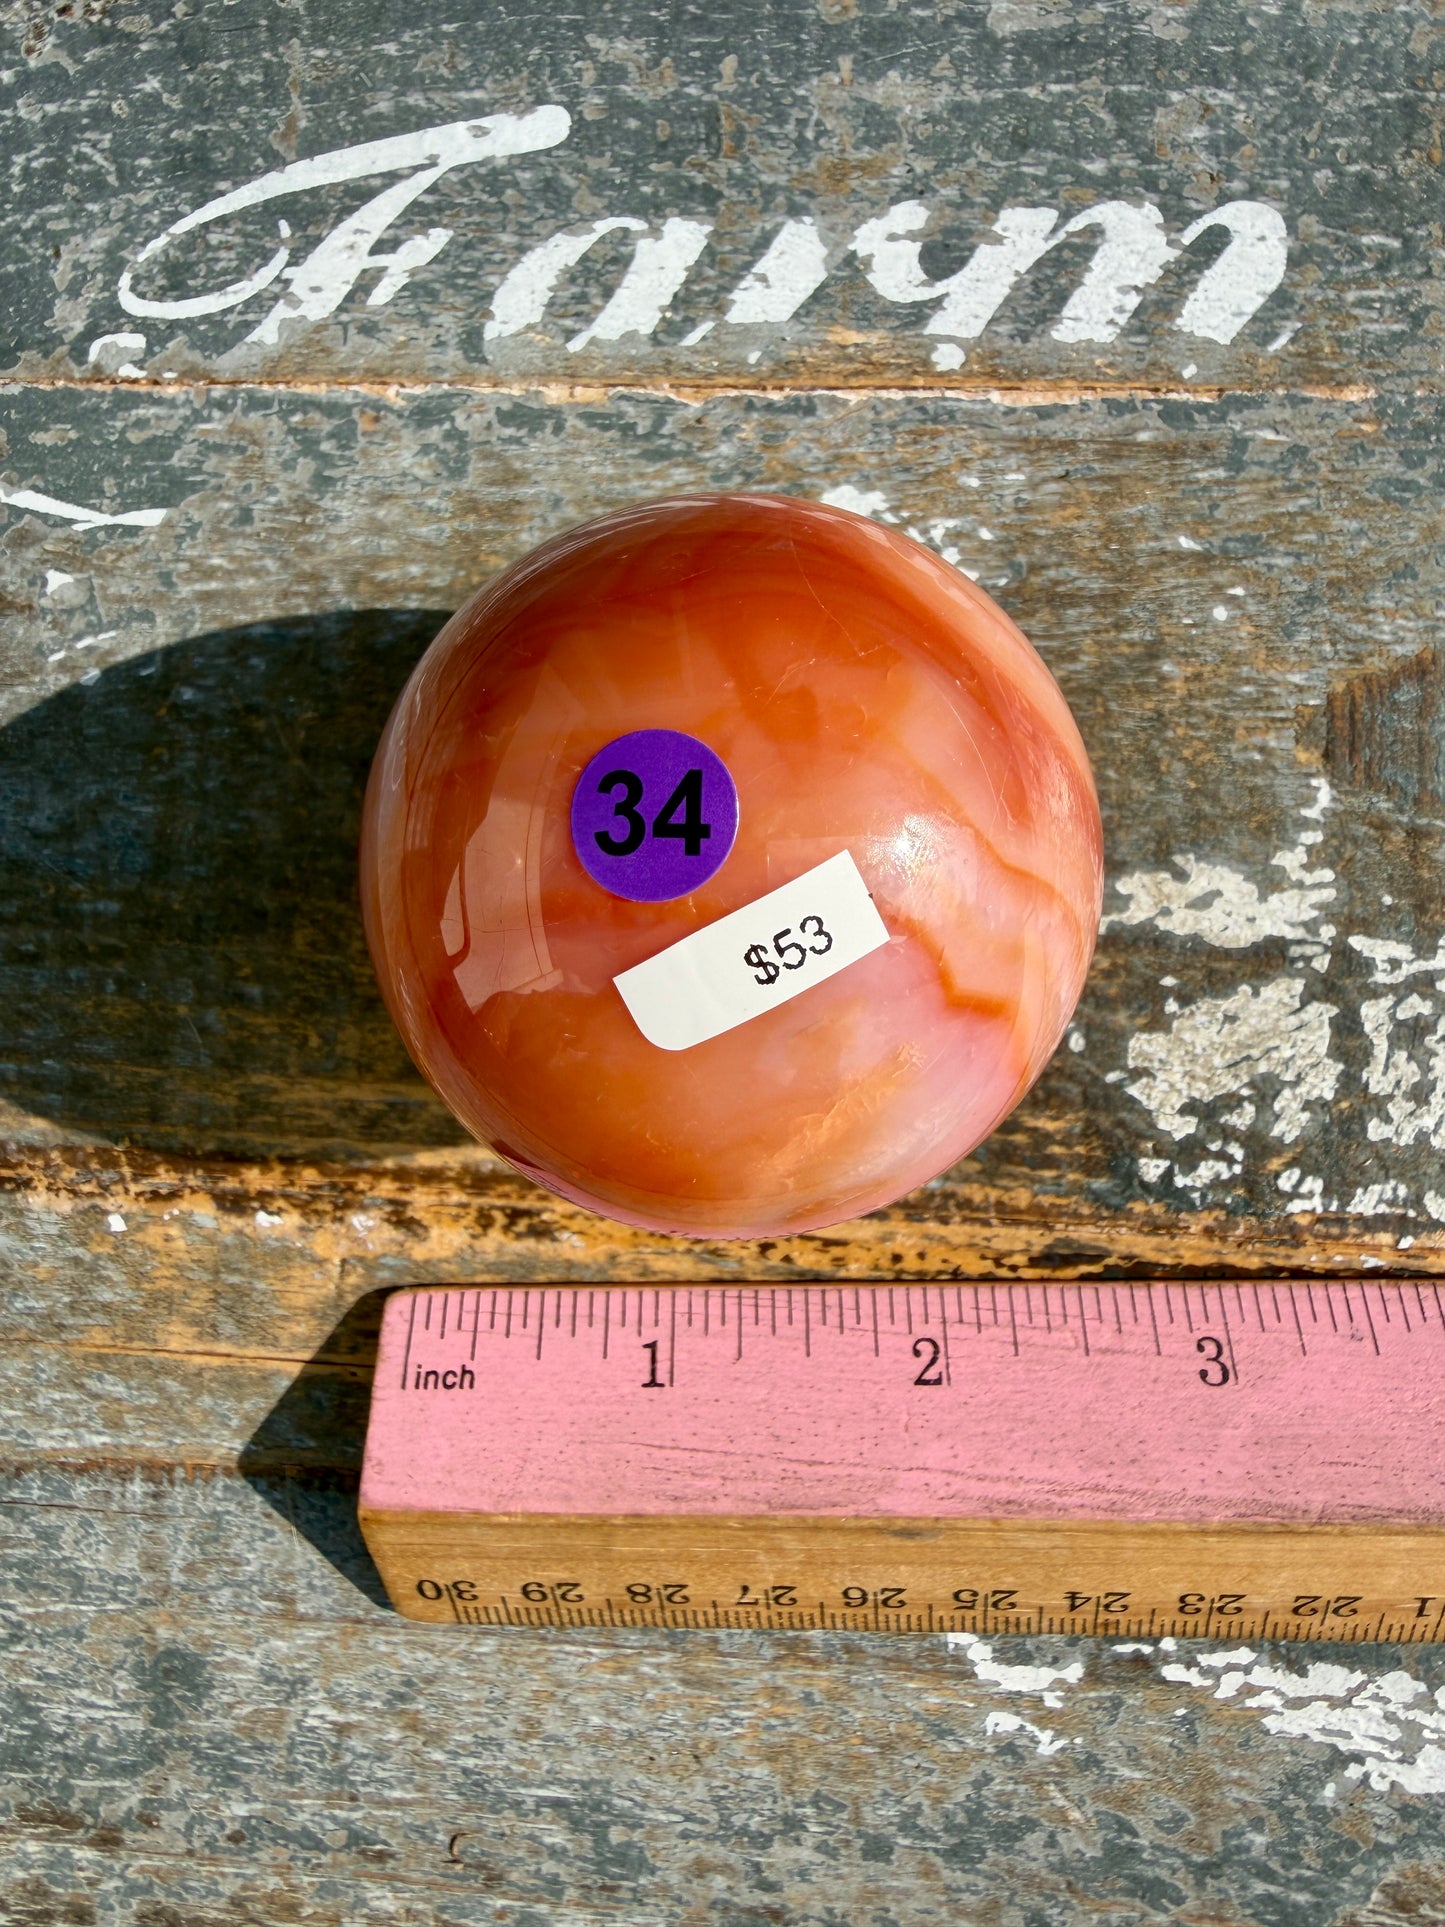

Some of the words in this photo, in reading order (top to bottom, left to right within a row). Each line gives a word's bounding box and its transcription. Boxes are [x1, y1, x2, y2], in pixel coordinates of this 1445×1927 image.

[594, 769, 711, 856] 34
[743, 915, 833, 985] $53
[414, 1364, 475, 1390] inch
[641, 1340, 665, 1388] 1
[912, 1338, 943, 1386] 2
[1197, 1337, 1230, 1387] 3
[416, 1579, 478, 1602] 30
[521, 1581, 584, 1603] 29
[627, 1583, 690, 1604] 28
[736, 1584, 797, 1606] 27
[842, 1587, 906, 1608] 26
[952, 1588, 1018, 1611] 25
[1063, 1590, 1132, 1613] 24
[1178, 1592, 1248, 1616] 23
[1292, 1594, 1364, 1617] 22
